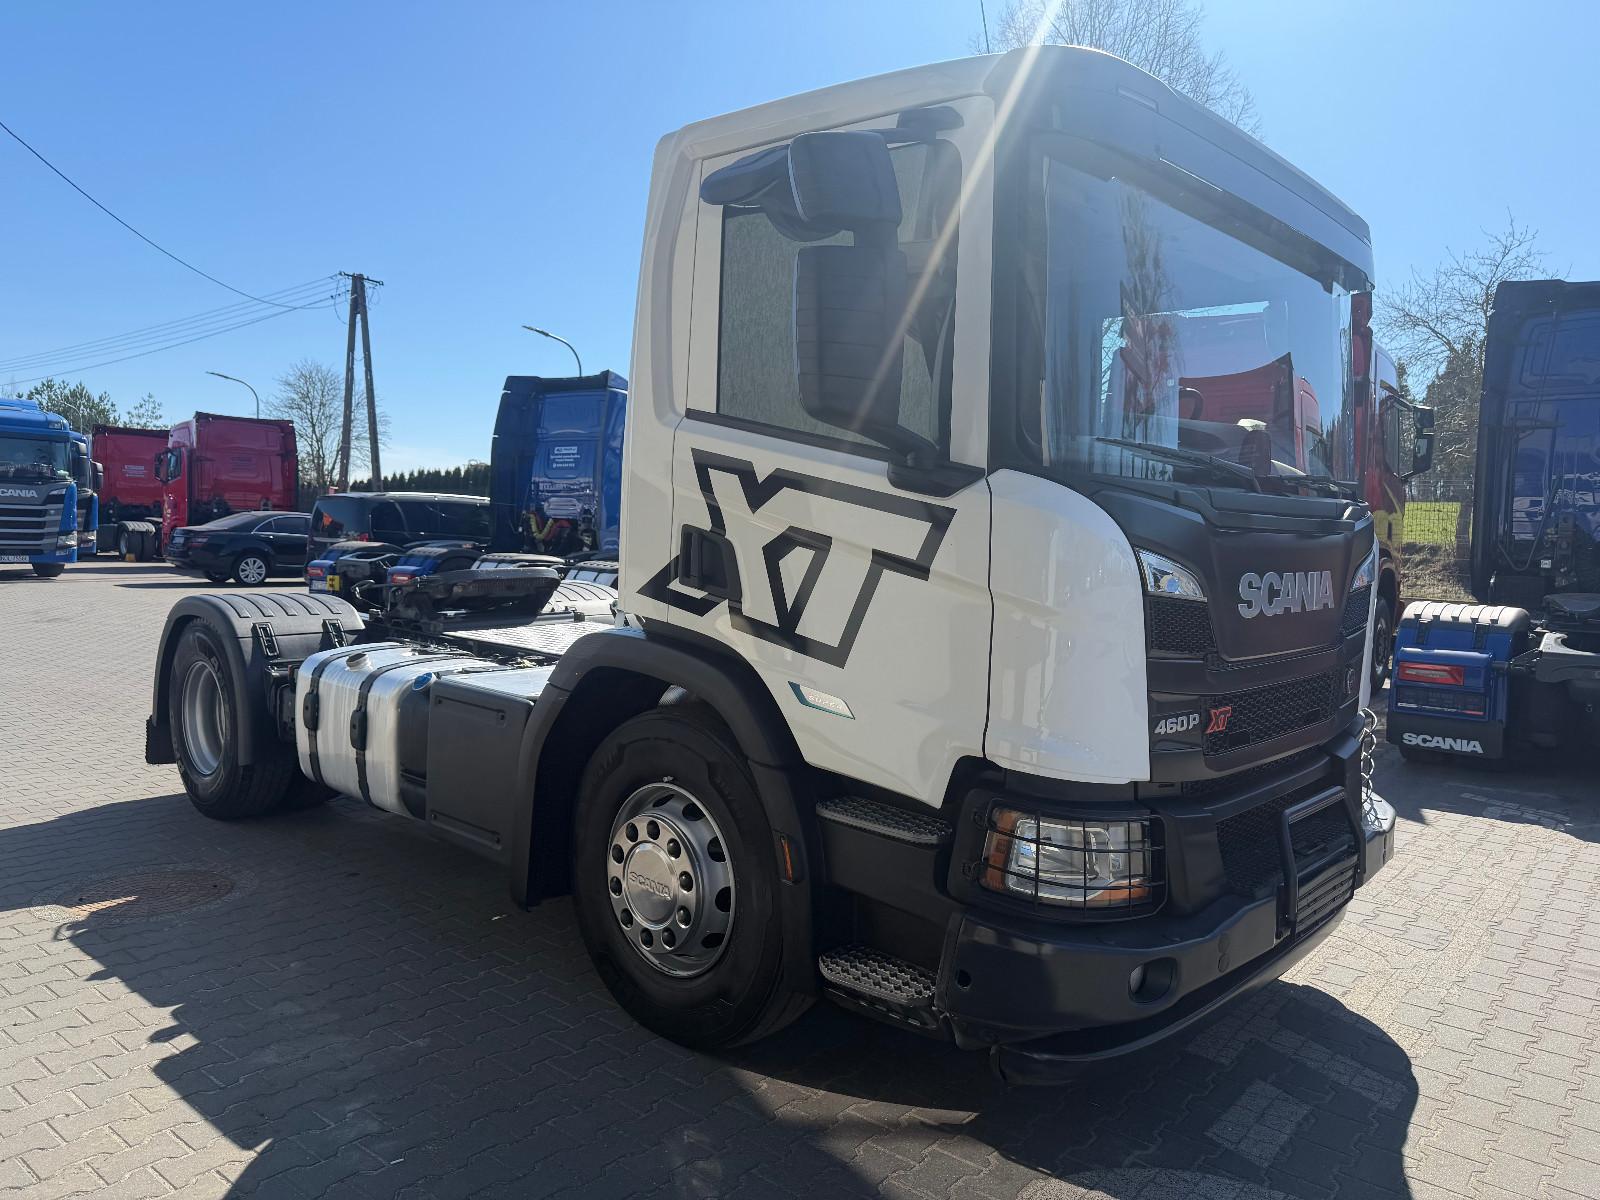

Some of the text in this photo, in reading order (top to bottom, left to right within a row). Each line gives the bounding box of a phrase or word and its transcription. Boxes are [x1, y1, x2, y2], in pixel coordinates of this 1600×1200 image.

[0, 488, 37, 498] CANIA
[637, 448, 957, 669] XT
[1238, 570, 1335, 619] SCANIA
[1206, 706, 1232, 734] XT
[1402, 732, 1484, 754] SCANIA
[628, 871, 672, 899] SCANIA
